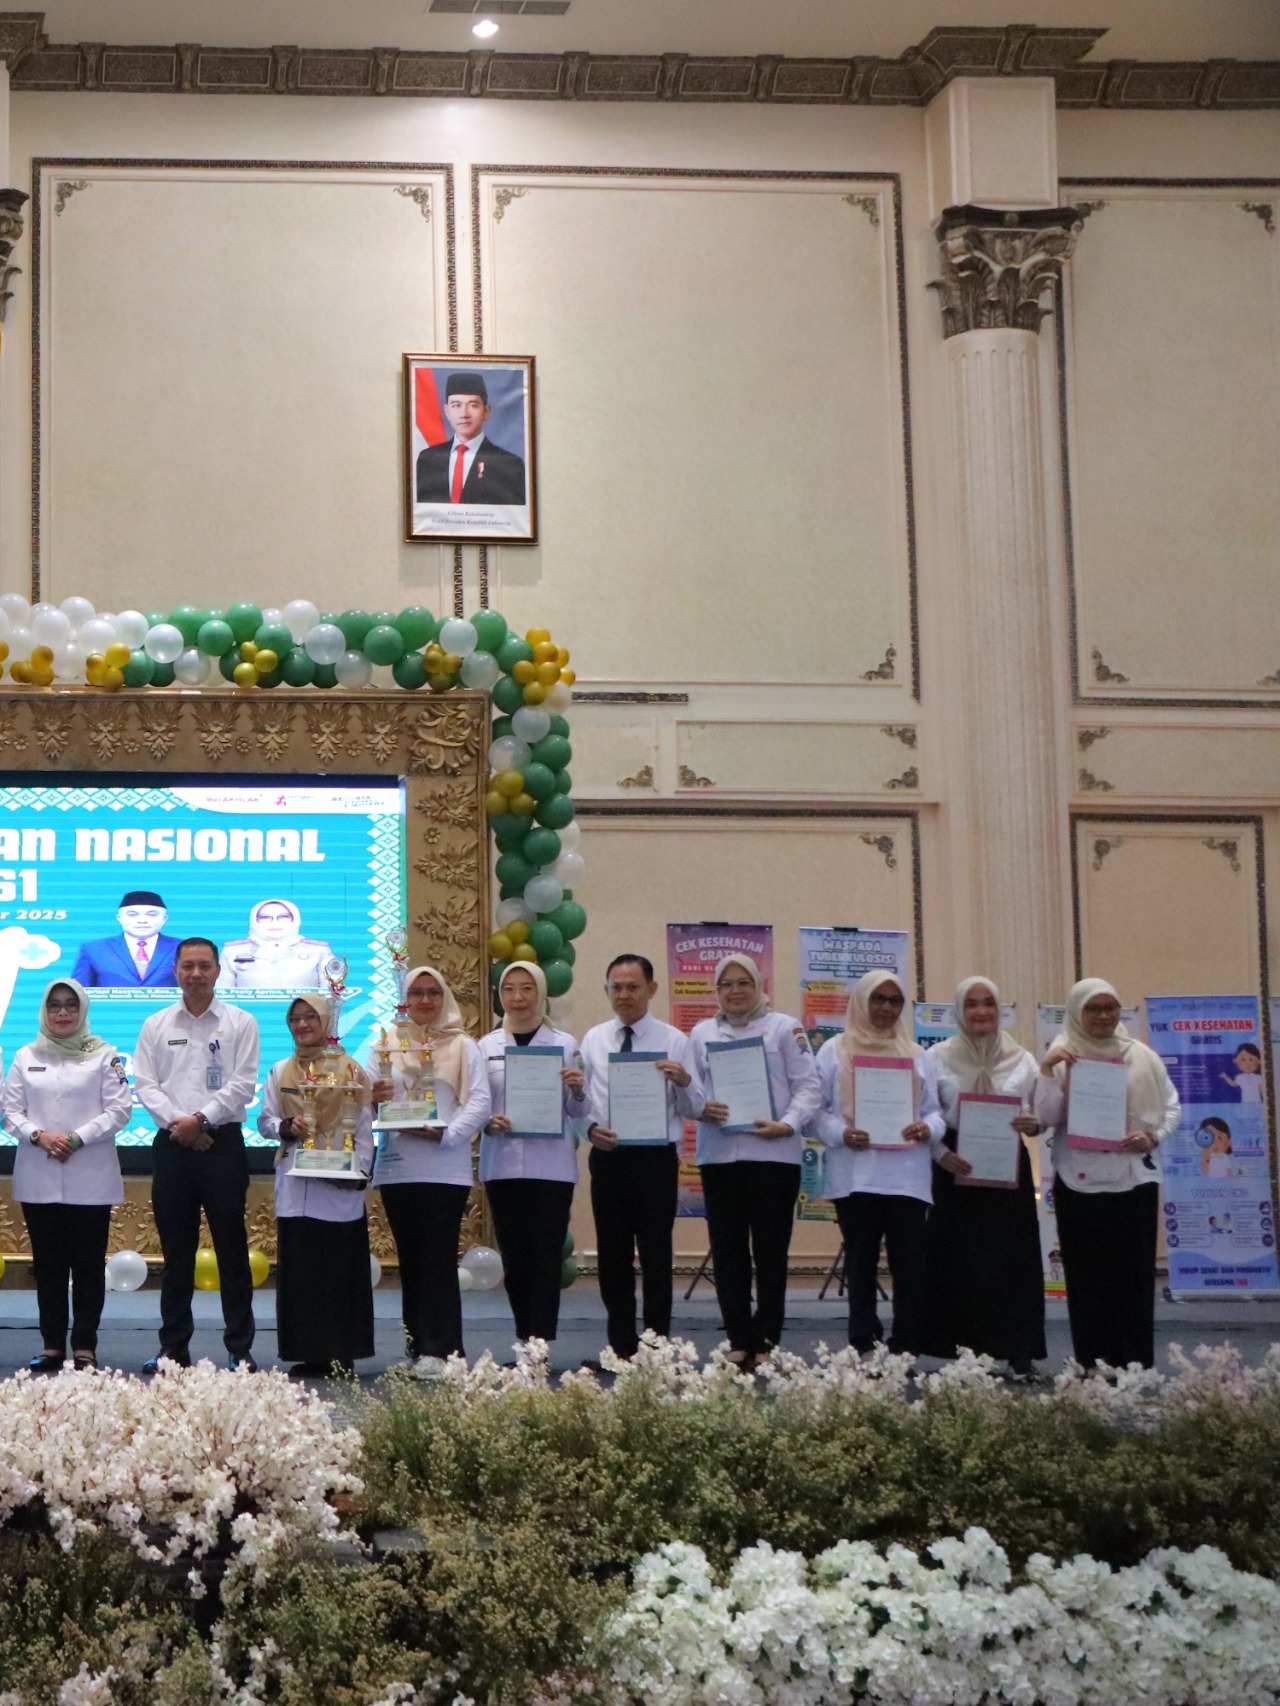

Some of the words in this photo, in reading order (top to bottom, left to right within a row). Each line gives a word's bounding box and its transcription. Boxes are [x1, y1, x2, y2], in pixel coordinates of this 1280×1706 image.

[75, 828, 326, 862] NASIONAL
[15, 909, 68, 920] 2025
[675, 939, 697, 953] CEK
[697, 937, 765, 954] KESEHATAN
[822, 939, 882, 952] WASPADA
[699, 950, 742, 961] GRAT
[1149, 1023, 1169, 1032] YUK
[1173, 1021, 1192, 1031] CEK
[1194, 1020, 1254, 1031] KESEHATAN
[1190, 1036, 1223, 1045] GRATIS
